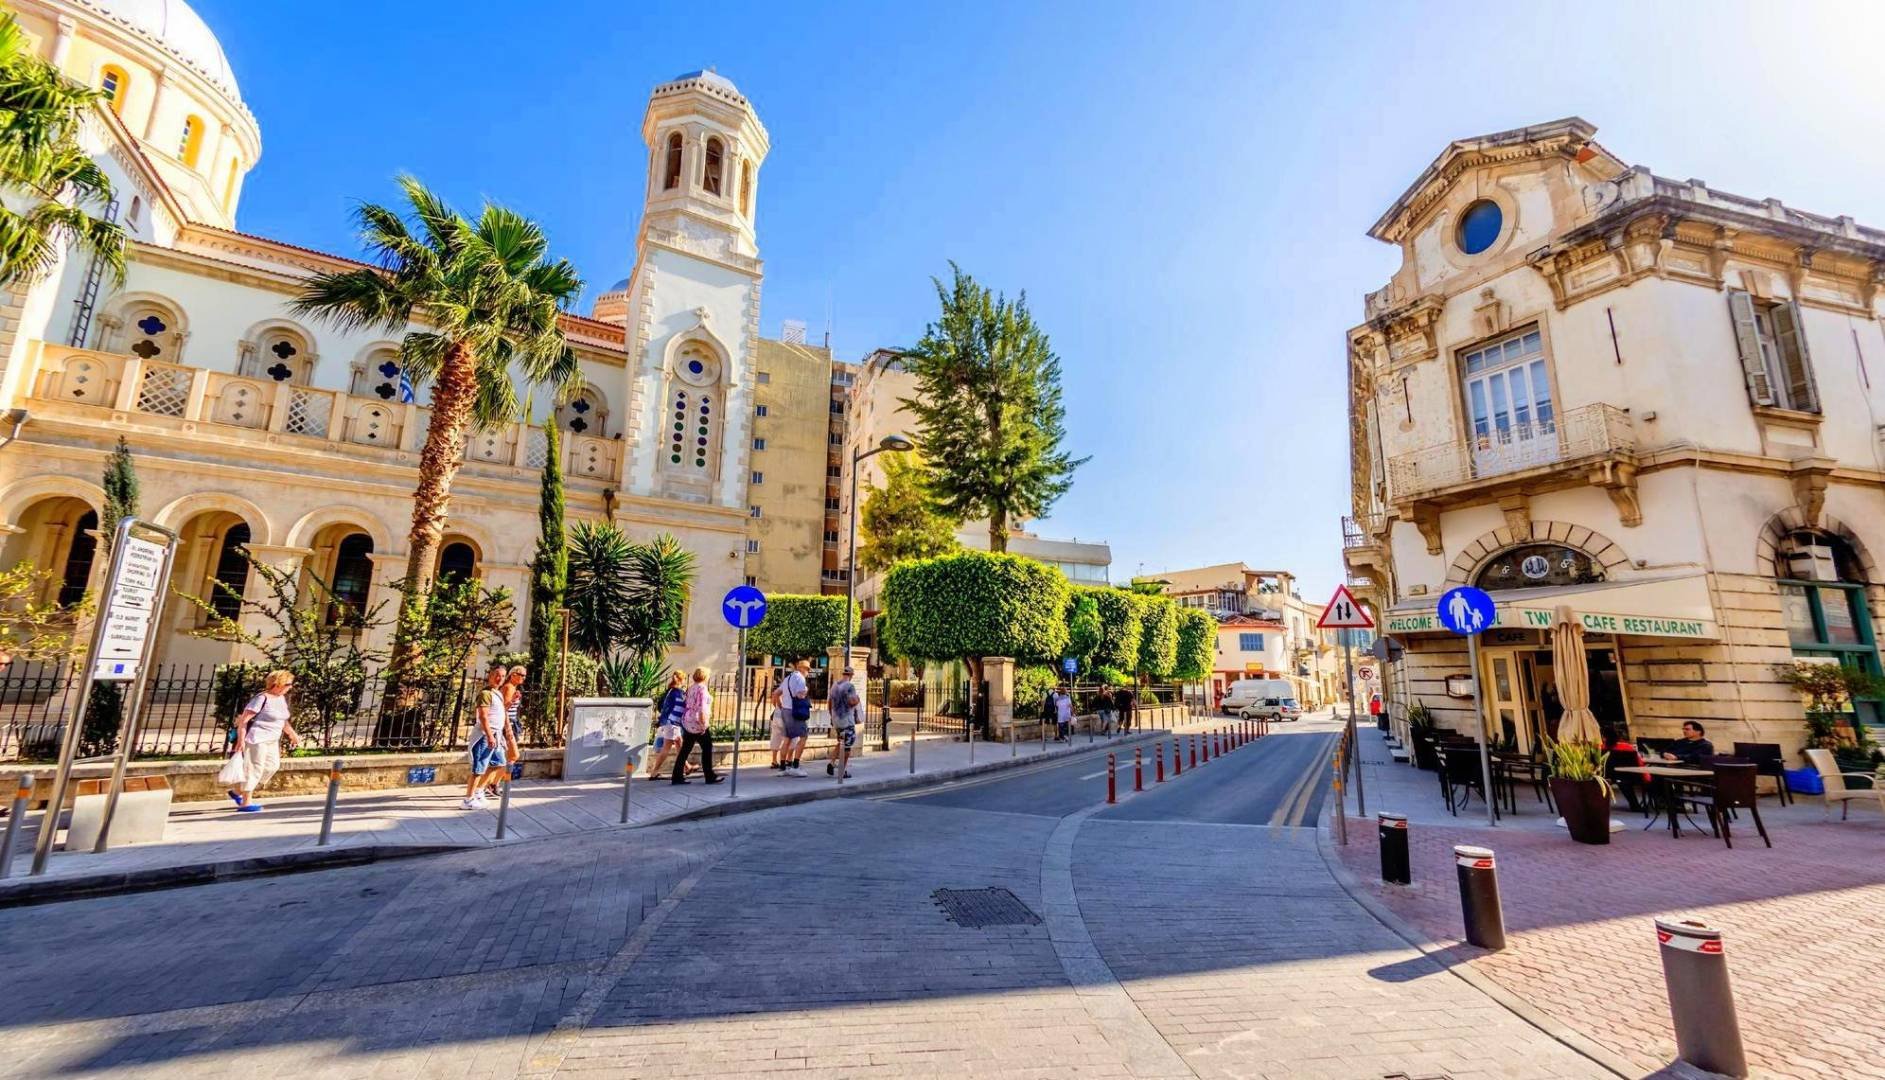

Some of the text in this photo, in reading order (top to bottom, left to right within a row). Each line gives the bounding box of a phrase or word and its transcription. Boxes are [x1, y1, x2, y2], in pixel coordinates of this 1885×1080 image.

[1390, 616, 1432, 631] WELCOME
[1583, 614, 1617, 631] CAFE
[1623, 618, 1704, 636] RESTAURANT
